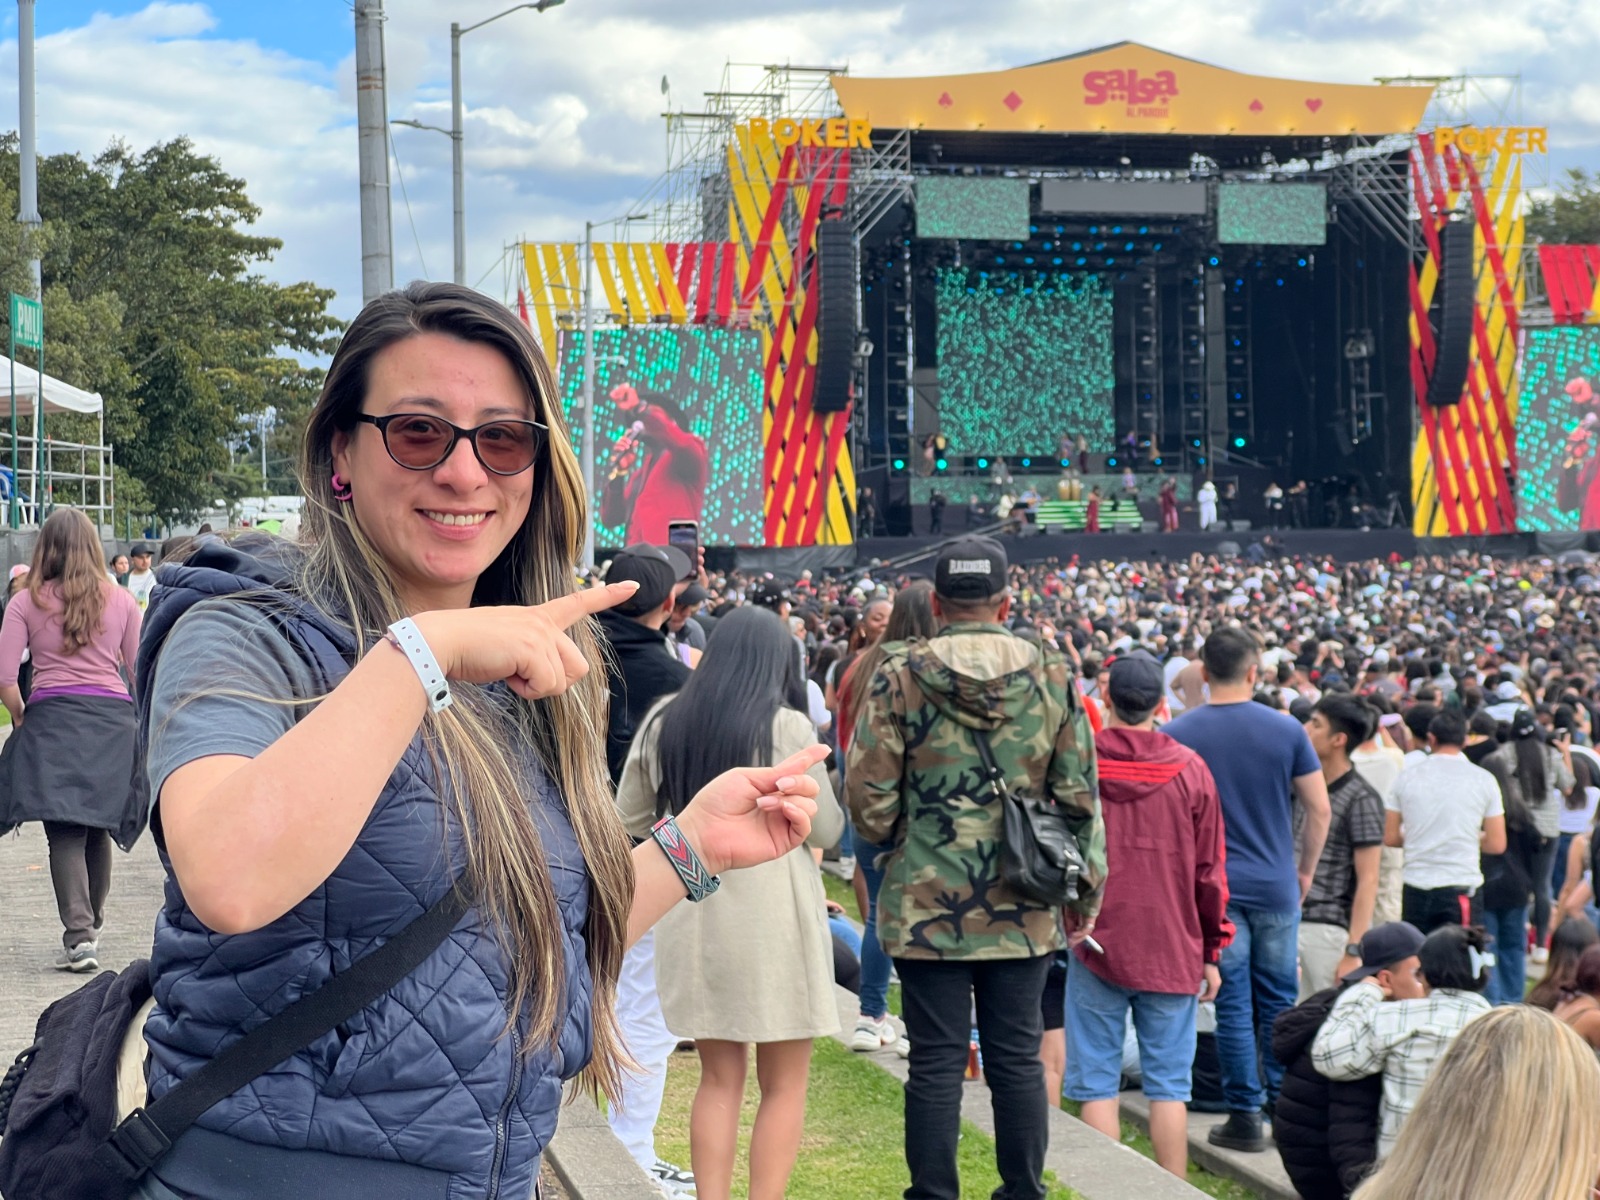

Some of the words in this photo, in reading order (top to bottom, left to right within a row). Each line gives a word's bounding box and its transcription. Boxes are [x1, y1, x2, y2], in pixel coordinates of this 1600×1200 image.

[749, 117, 873, 148] POKER
[1435, 125, 1547, 154] POKER
[17, 301, 41, 344] PMU
